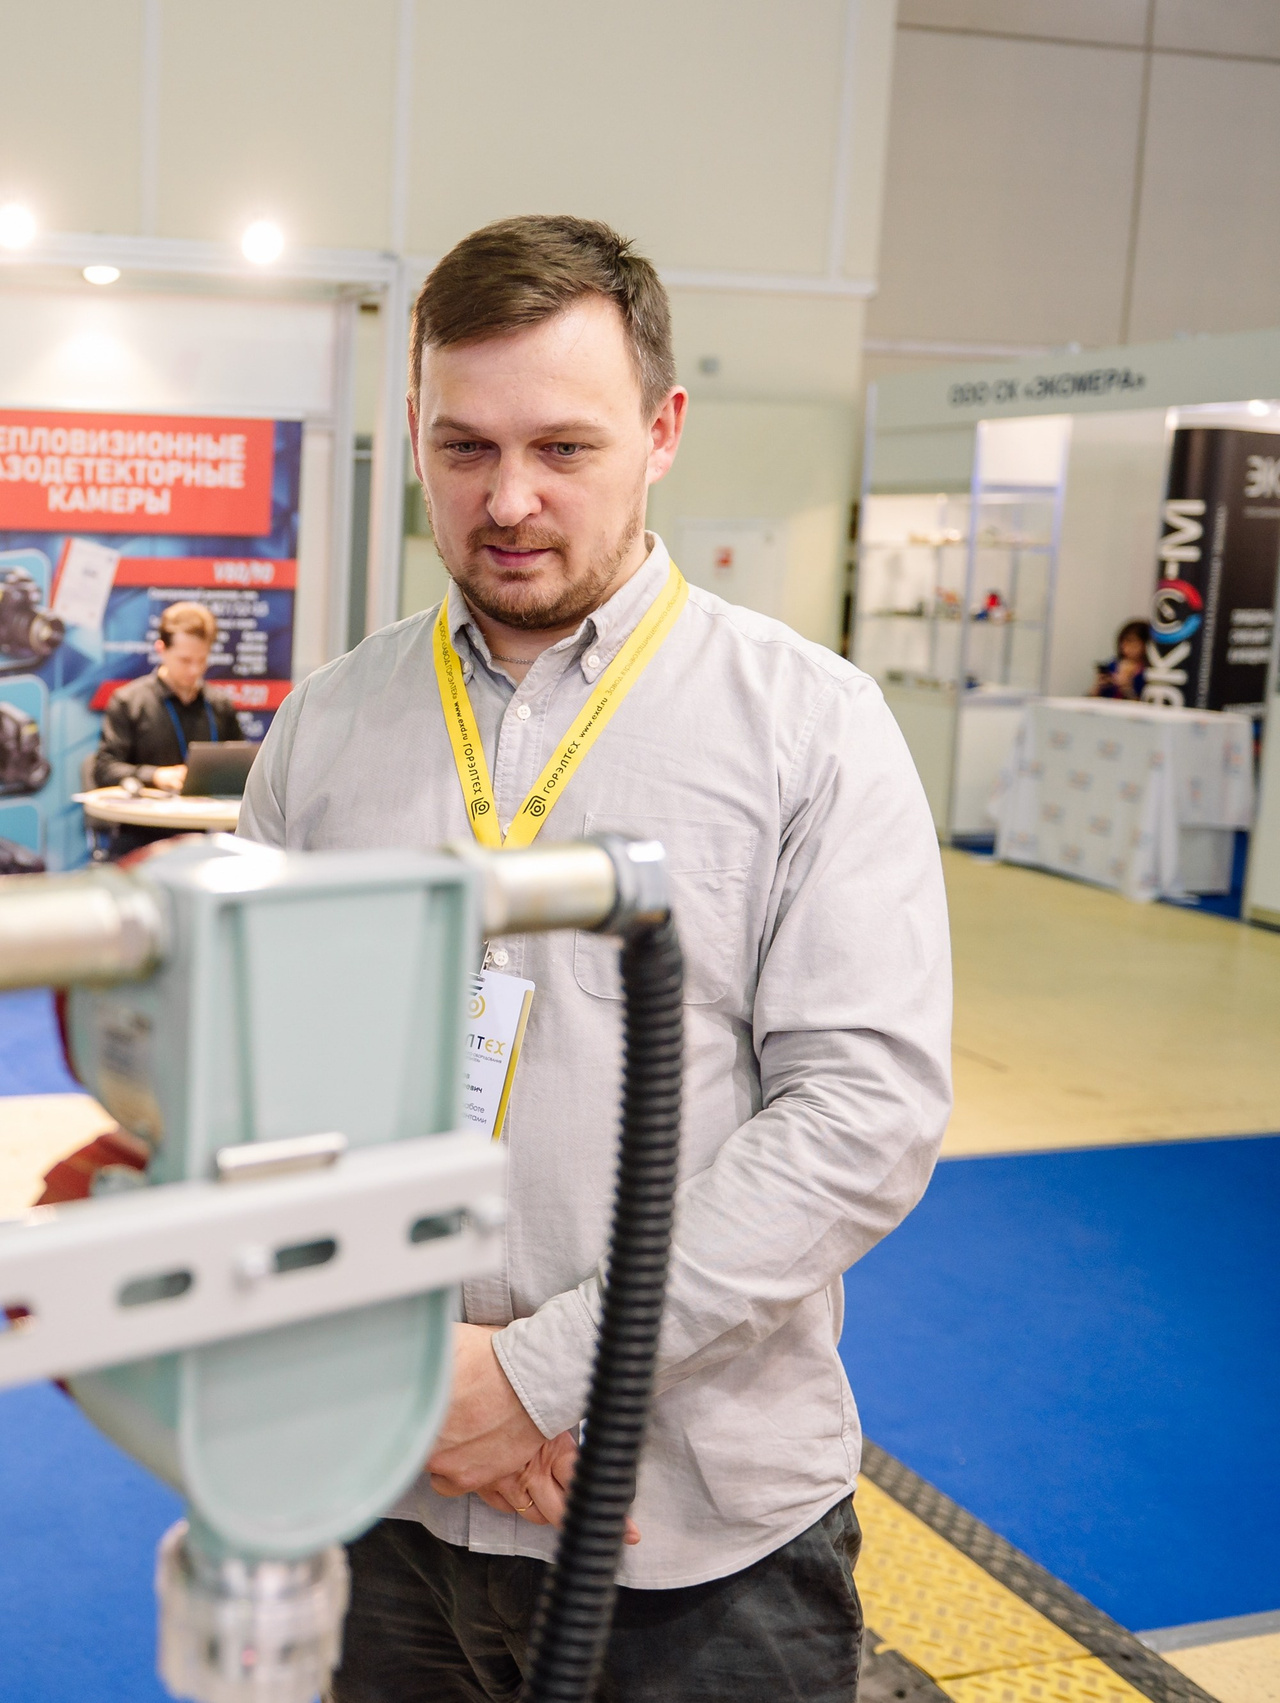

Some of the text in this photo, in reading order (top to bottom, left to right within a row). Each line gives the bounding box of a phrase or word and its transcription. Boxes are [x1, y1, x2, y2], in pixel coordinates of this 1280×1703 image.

[47, 485, 171, 515] КАМЕРЫ
[453, 701, 468, 741] www.exd.ru
[463, 743, 483, 795] ГОРЭЛТЕХ
[543, 741, 581, 794] ГОРЭЛТЕХ
[579, 697, 608, 738] www.exd.ru
